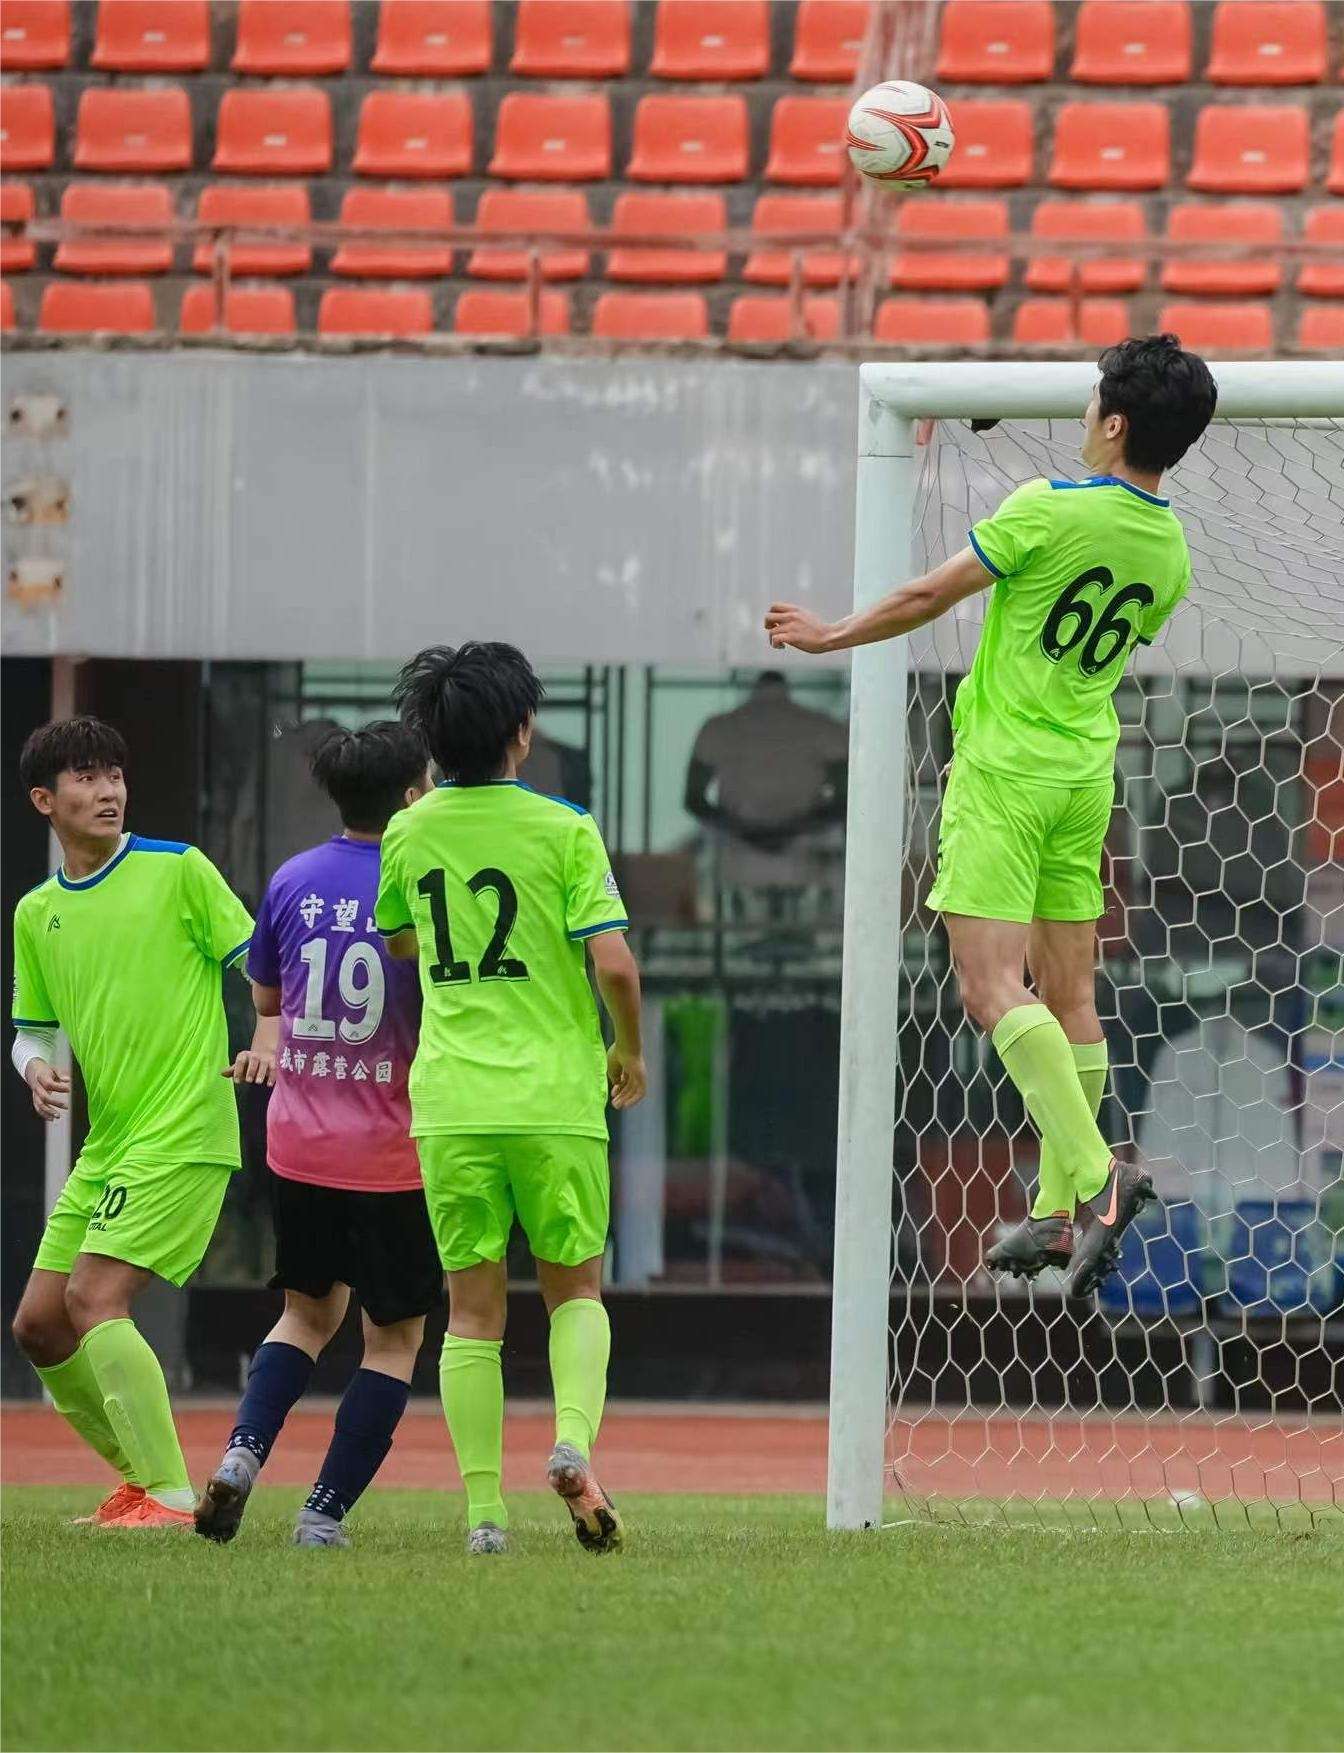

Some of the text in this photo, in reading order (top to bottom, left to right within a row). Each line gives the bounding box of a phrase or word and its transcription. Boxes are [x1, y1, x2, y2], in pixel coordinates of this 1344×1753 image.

[1039, 565, 1154, 678] 66
[300, 893, 378, 934] 守望
[417, 867, 531, 987] 12
[292, 937, 385, 1045] 19
